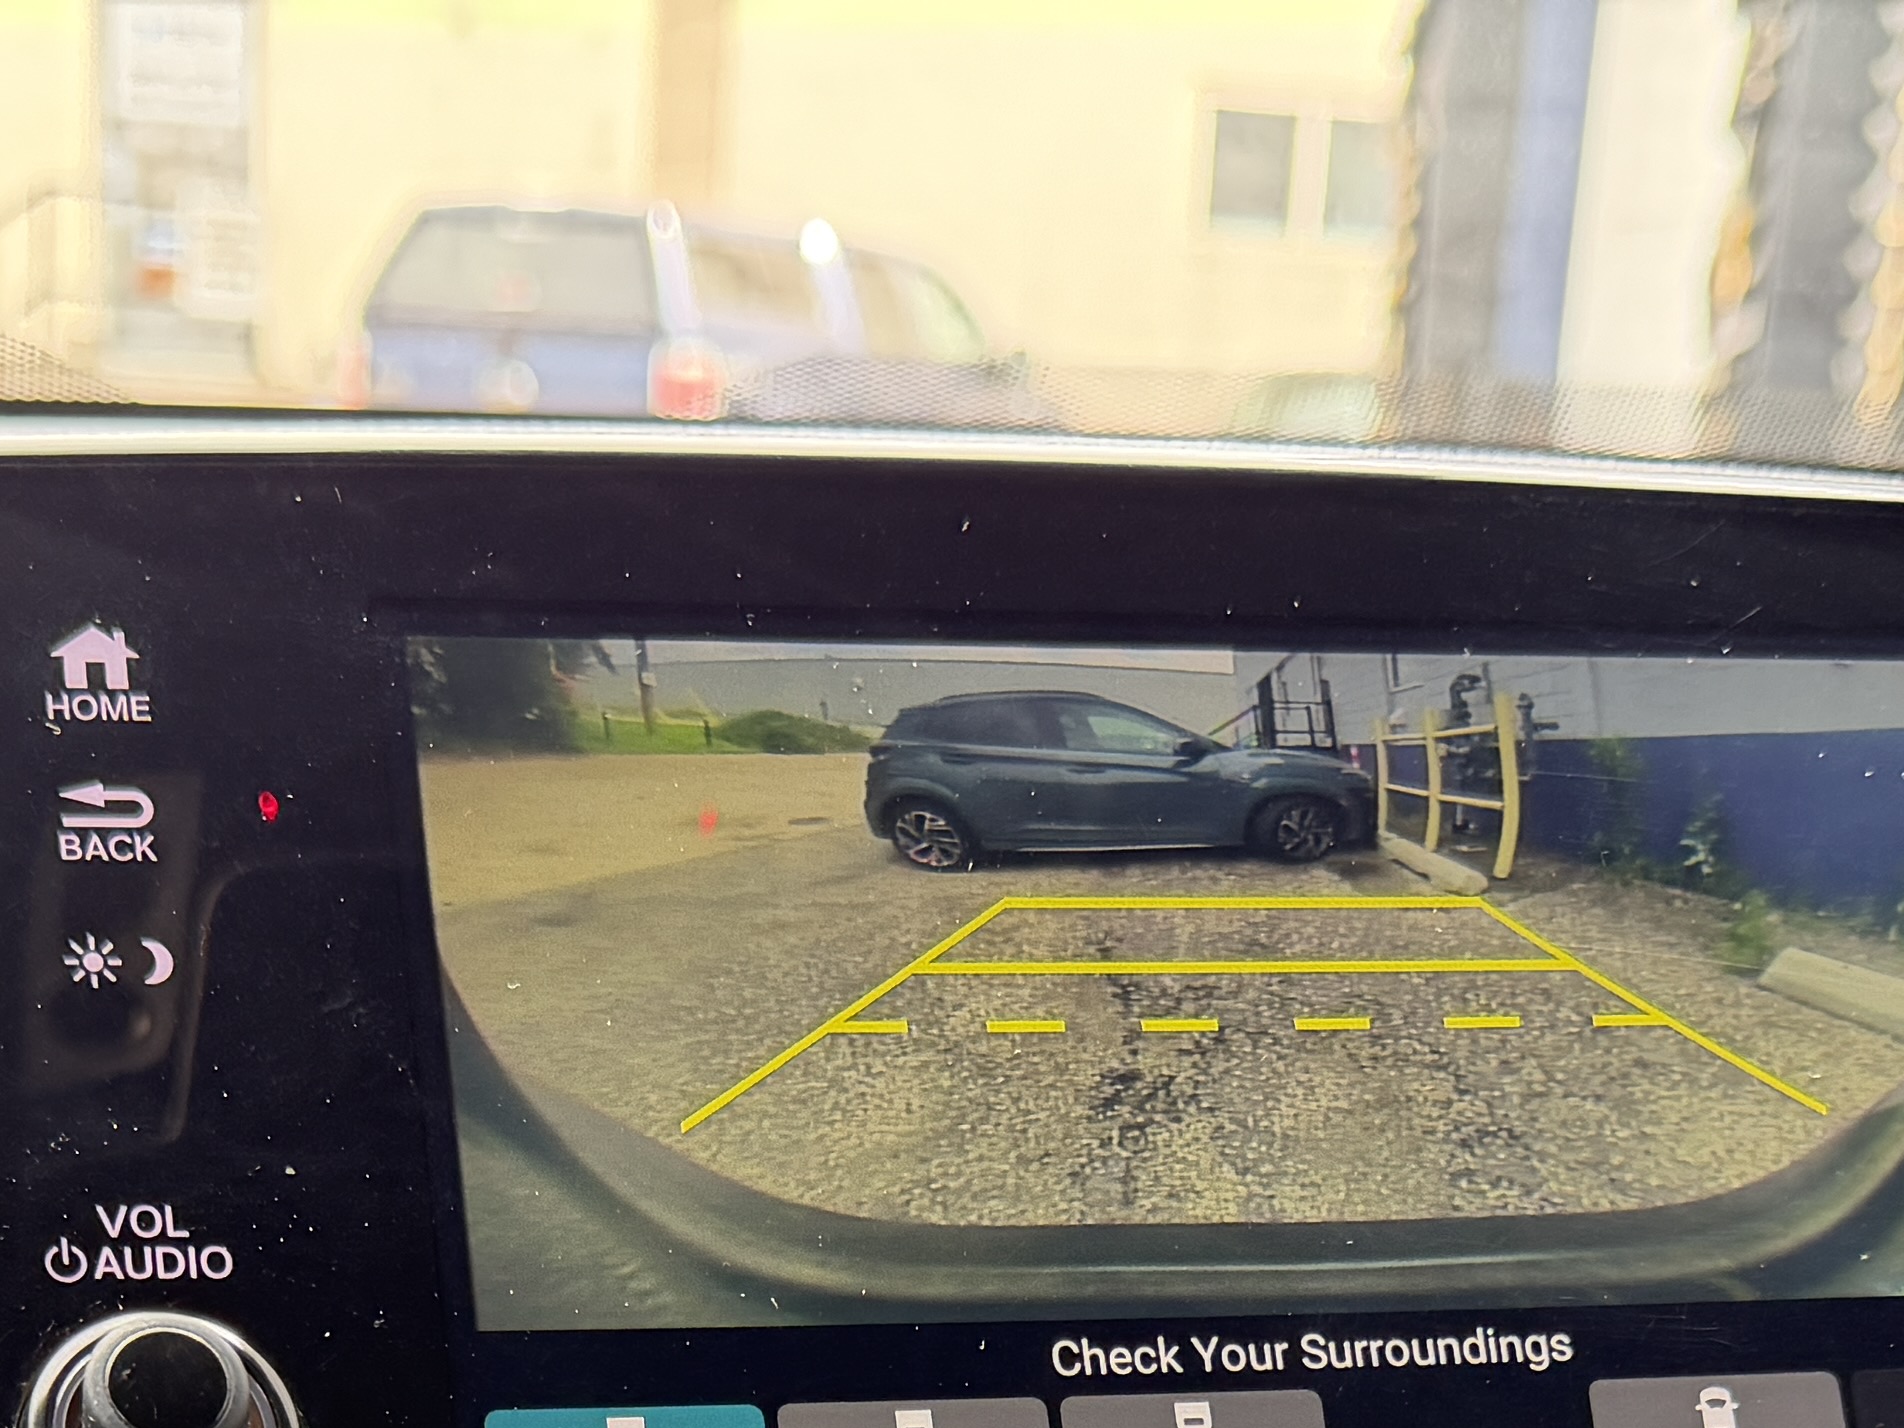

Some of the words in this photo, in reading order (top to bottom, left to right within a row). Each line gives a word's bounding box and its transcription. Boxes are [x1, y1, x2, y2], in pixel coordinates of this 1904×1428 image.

[44, 694, 153, 722] HOME
[57, 834, 159, 863] BACK
[94, 1203, 191, 1239] VOL
[93, 1244, 234, 1281] AUDIO
[1050, 1334, 1185, 1378] Check
[1189, 1334, 1290, 1374] Your
[1299, 1325, 1575, 1373] Surroundings
